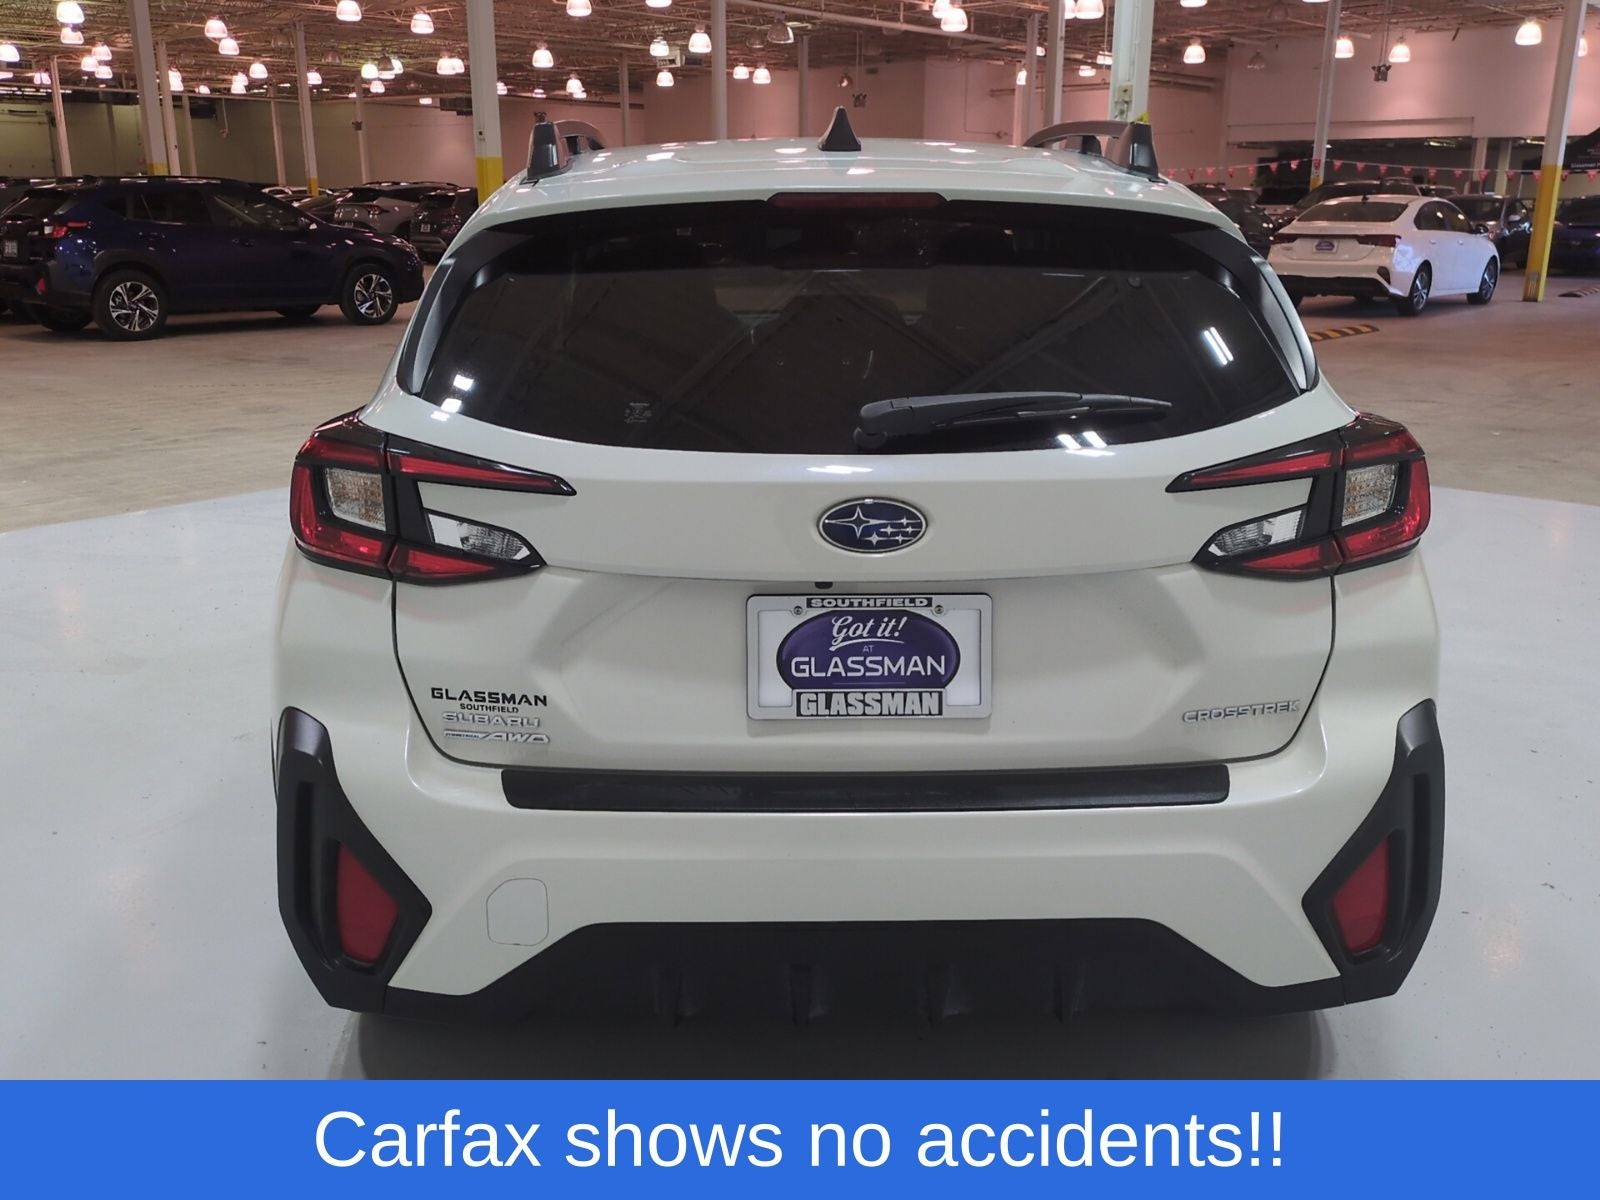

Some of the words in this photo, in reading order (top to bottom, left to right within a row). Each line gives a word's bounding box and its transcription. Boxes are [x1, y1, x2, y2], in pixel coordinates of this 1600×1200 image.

[810, 598, 928, 608] SOUTHFIELD
[830, 615, 874, 645] Got
[876, 616, 908, 638] it!
[862, 645, 875, 653] AT
[791, 655, 945, 677] GLASSMAN
[431, 687, 548, 707] GLASSMAN
[800, 692, 939, 717] GLASSMAN
[460, 703, 519, 714] SOUTHFIELD
[1182, 700, 1300, 722] CROSSTREK
[442, 711, 540, 728] SUBARU
[482, 732, 550, 744] AWD
